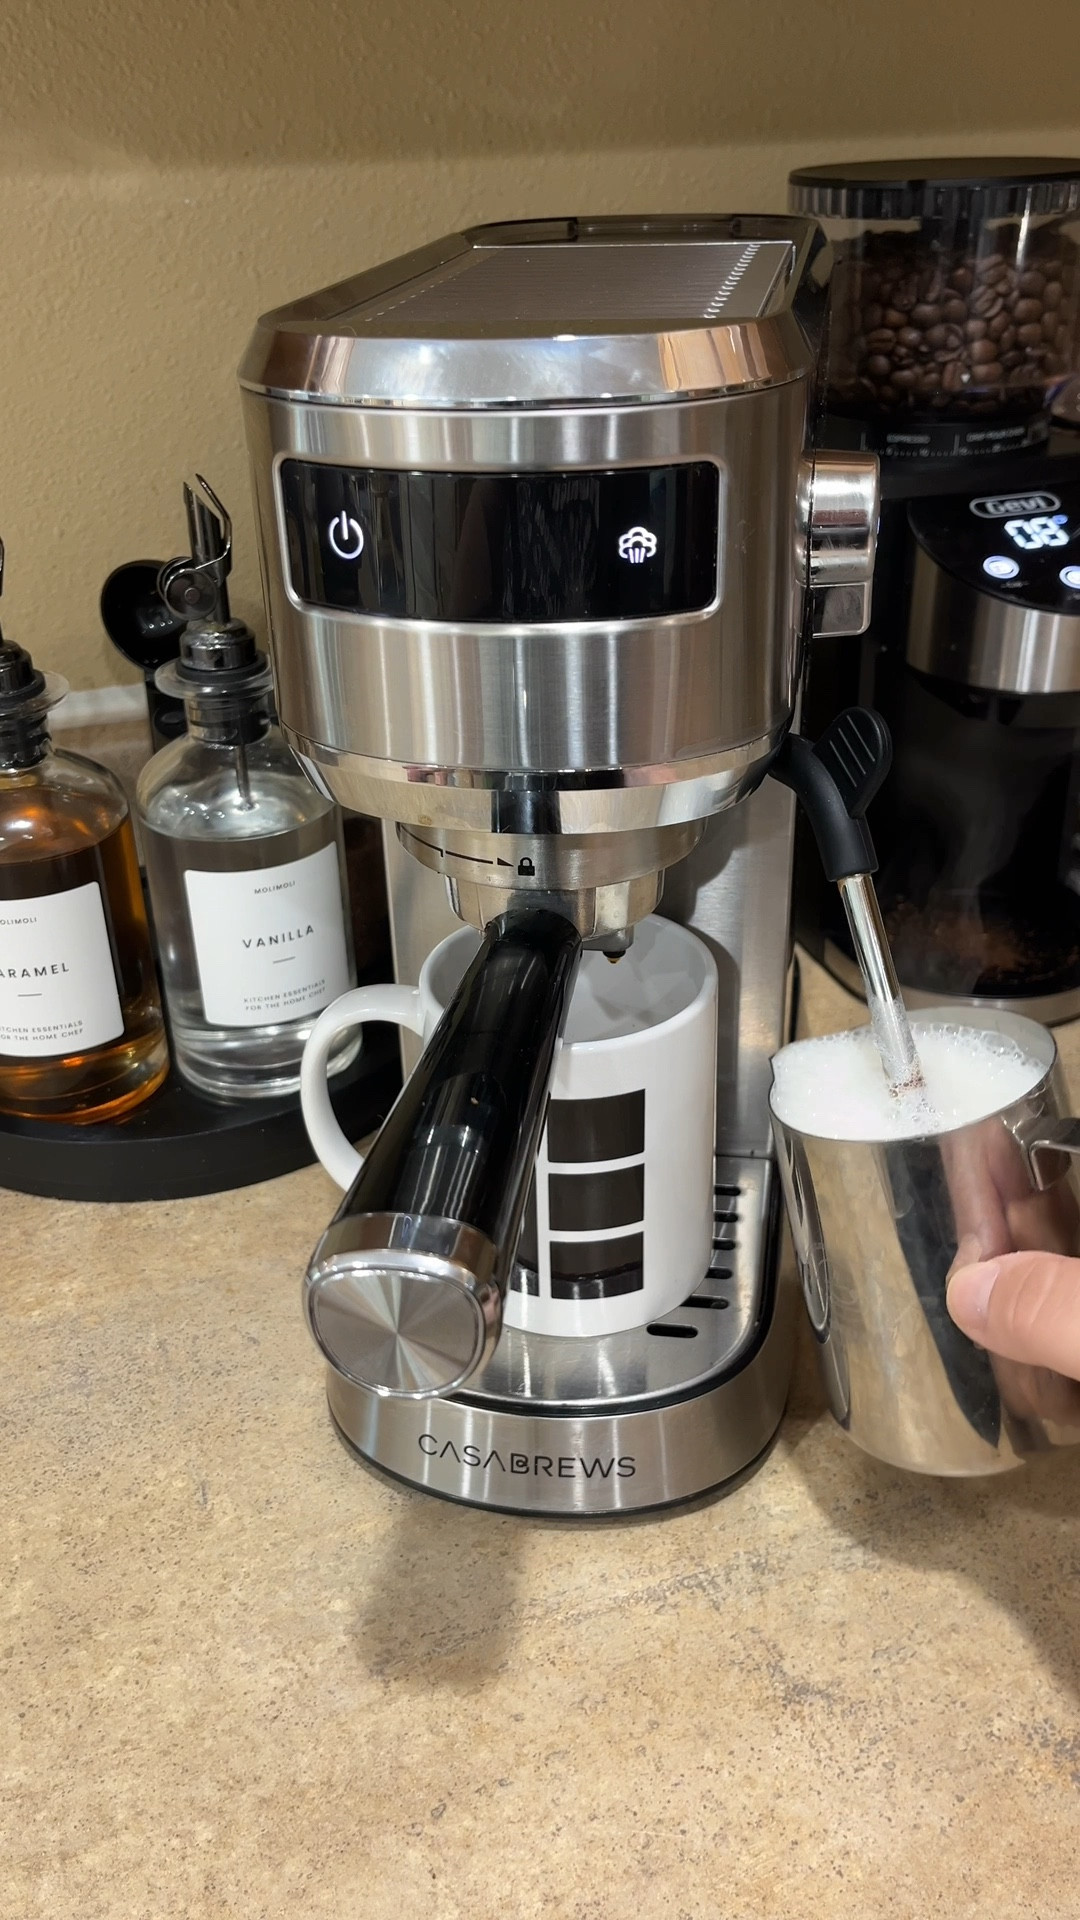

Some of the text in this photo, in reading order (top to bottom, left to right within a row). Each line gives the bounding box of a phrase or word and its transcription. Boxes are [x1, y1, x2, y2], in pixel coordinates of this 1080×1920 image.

[985, 497, 1048, 515] Gevi
[253, 880, 296, 894] MOLIMOLI
[242, 924, 314, 949] VANILLA
[243, 978, 326, 1003] KITCHEN ESSENTIALS
[265, 1001, 280, 1009] THE
[283, 996, 306, 1006] HOME
[308, 986, 326, 998] CHEF
[32, 1019, 83, 1033] ESSENTIALS
[33, 1033, 58, 1041] HOME
[61, 1028, 83, 1038] CHEF
[418, 1433, 636, 1478] CASABREWS
